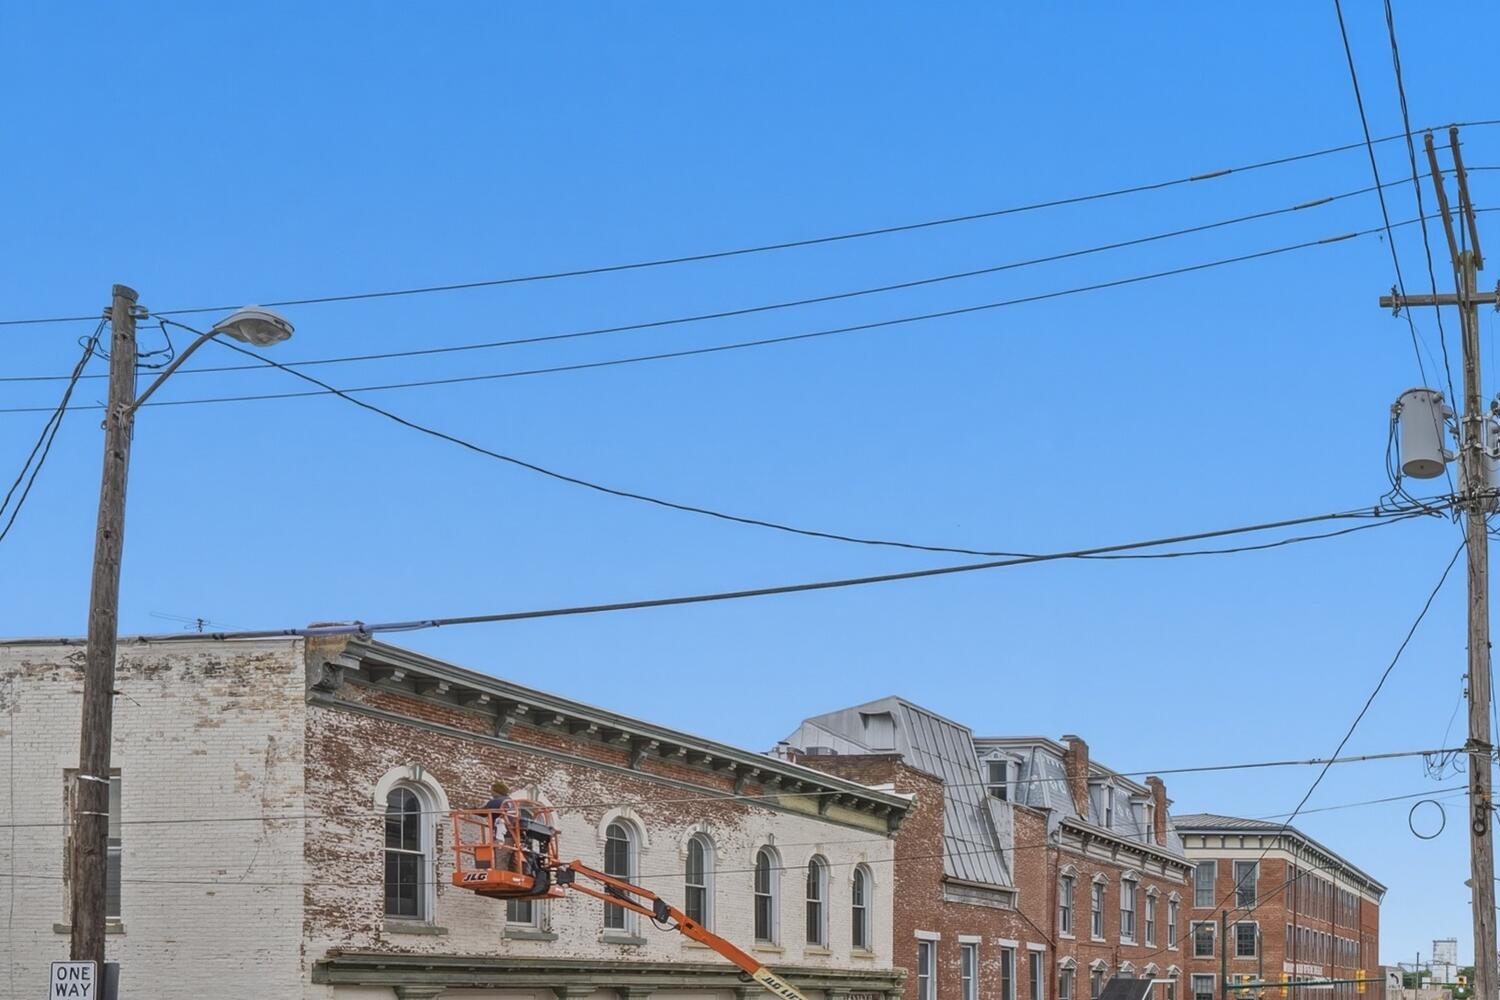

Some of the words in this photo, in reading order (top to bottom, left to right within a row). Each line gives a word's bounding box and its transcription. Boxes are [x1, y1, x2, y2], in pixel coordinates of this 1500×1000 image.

[463, 873, 488, 881] JLG
[57, 967, 90, 980] ONE
[56, 983, 91, 997] WAY
[762, 977, 782, 990] JLG
